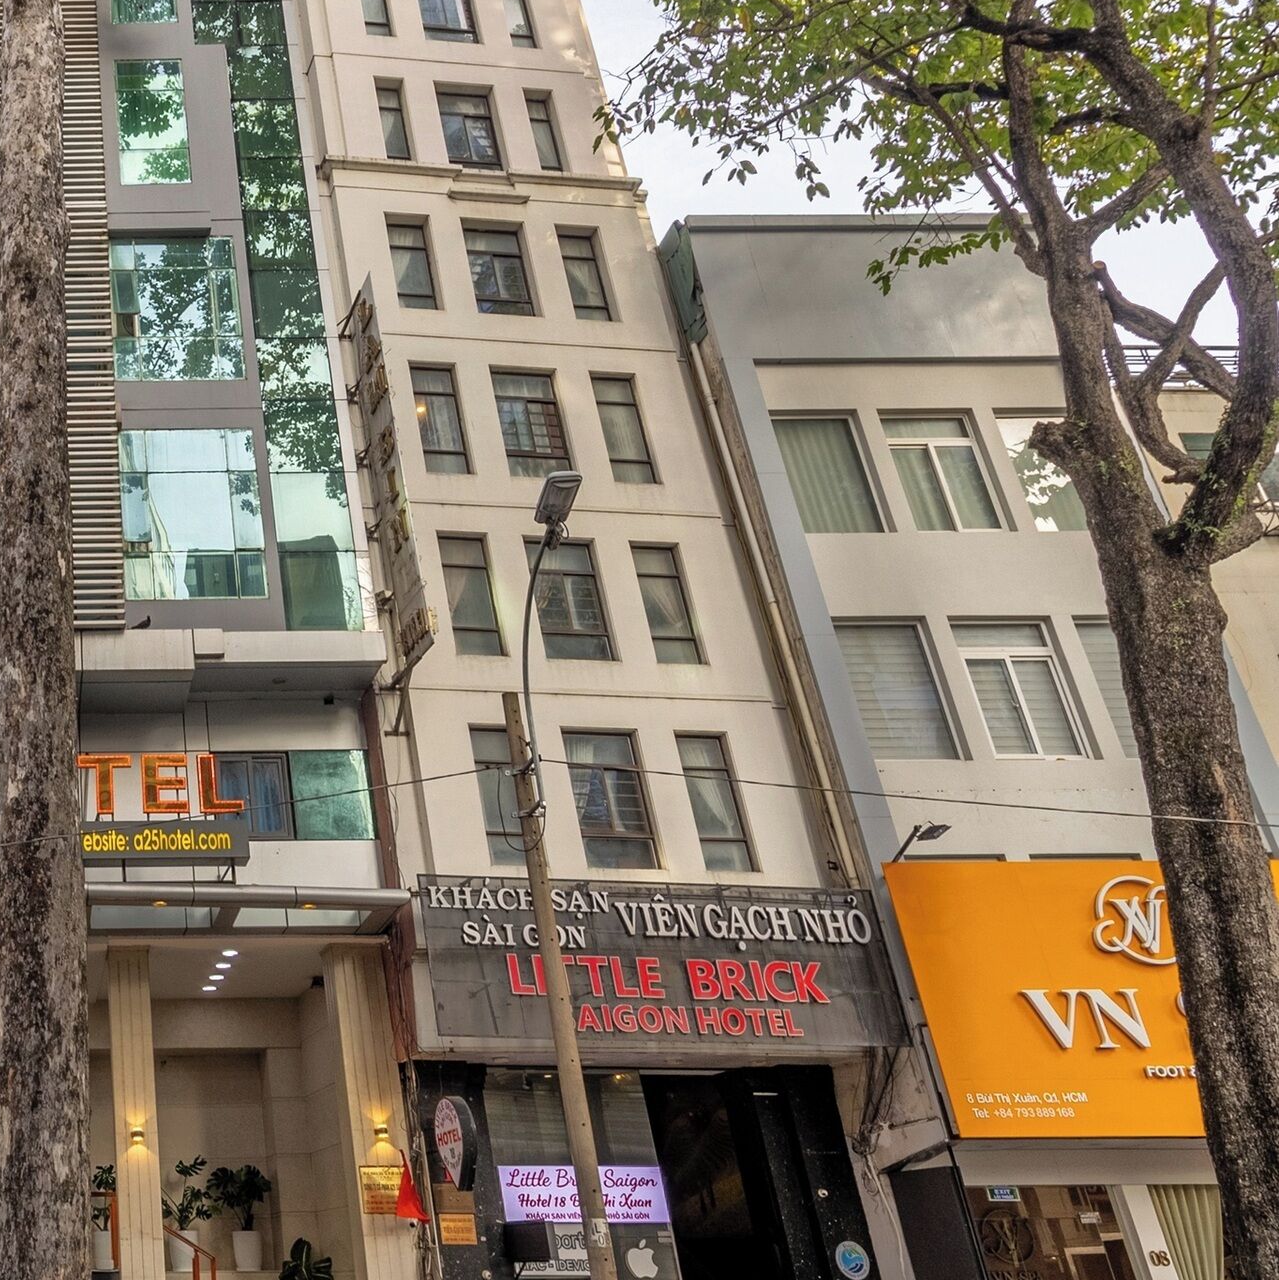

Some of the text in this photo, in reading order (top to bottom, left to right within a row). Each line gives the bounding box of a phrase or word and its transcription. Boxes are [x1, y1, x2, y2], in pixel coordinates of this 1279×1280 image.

[81, 830, 129, 852] ebsite:
[133, 829, 231, 851] a25hotel.com
[550, 888, 609, 920] SẠN
[462, 913, 517, 946] SÀI
[615, 893, 872, 952] VIÊN GẠCH NHỎ
[685, 958, 831, 1004] BRICK
[572, 1003, 804, 1037] AIGON HOTEL
[1019, 988, 1152, 1049] VN
[1146, 1065, 1186, 1078] FOOT
[966, 1093, 974, 1104] 8
[994, 1093, 1011, 1105] Thị
[1062, 1092, 1088, 1103] HCM
[993, 1108, 1013, 1118] +84
[1015, 1108, 1036, 1118] 793
[1036, 1108, 1055, 1118] 889
[1056, 1108, 1075, 1118] 168
[437, 1128, 462, 1147] HOTEL
[506, 1168, 552, 1188] Little
[603, 1168, 658, 1193] Saigon
[518, 1193, 552, 1208] Hotel
[554, 1196, 567, 1208] 18
[618, 1193, 652, 1210] Xuan
[621, 1211, 633, 1220] SÀI
[634, 1211, 650, 1220] GÒN
[1149, 1250, 1171, 1267] 08
